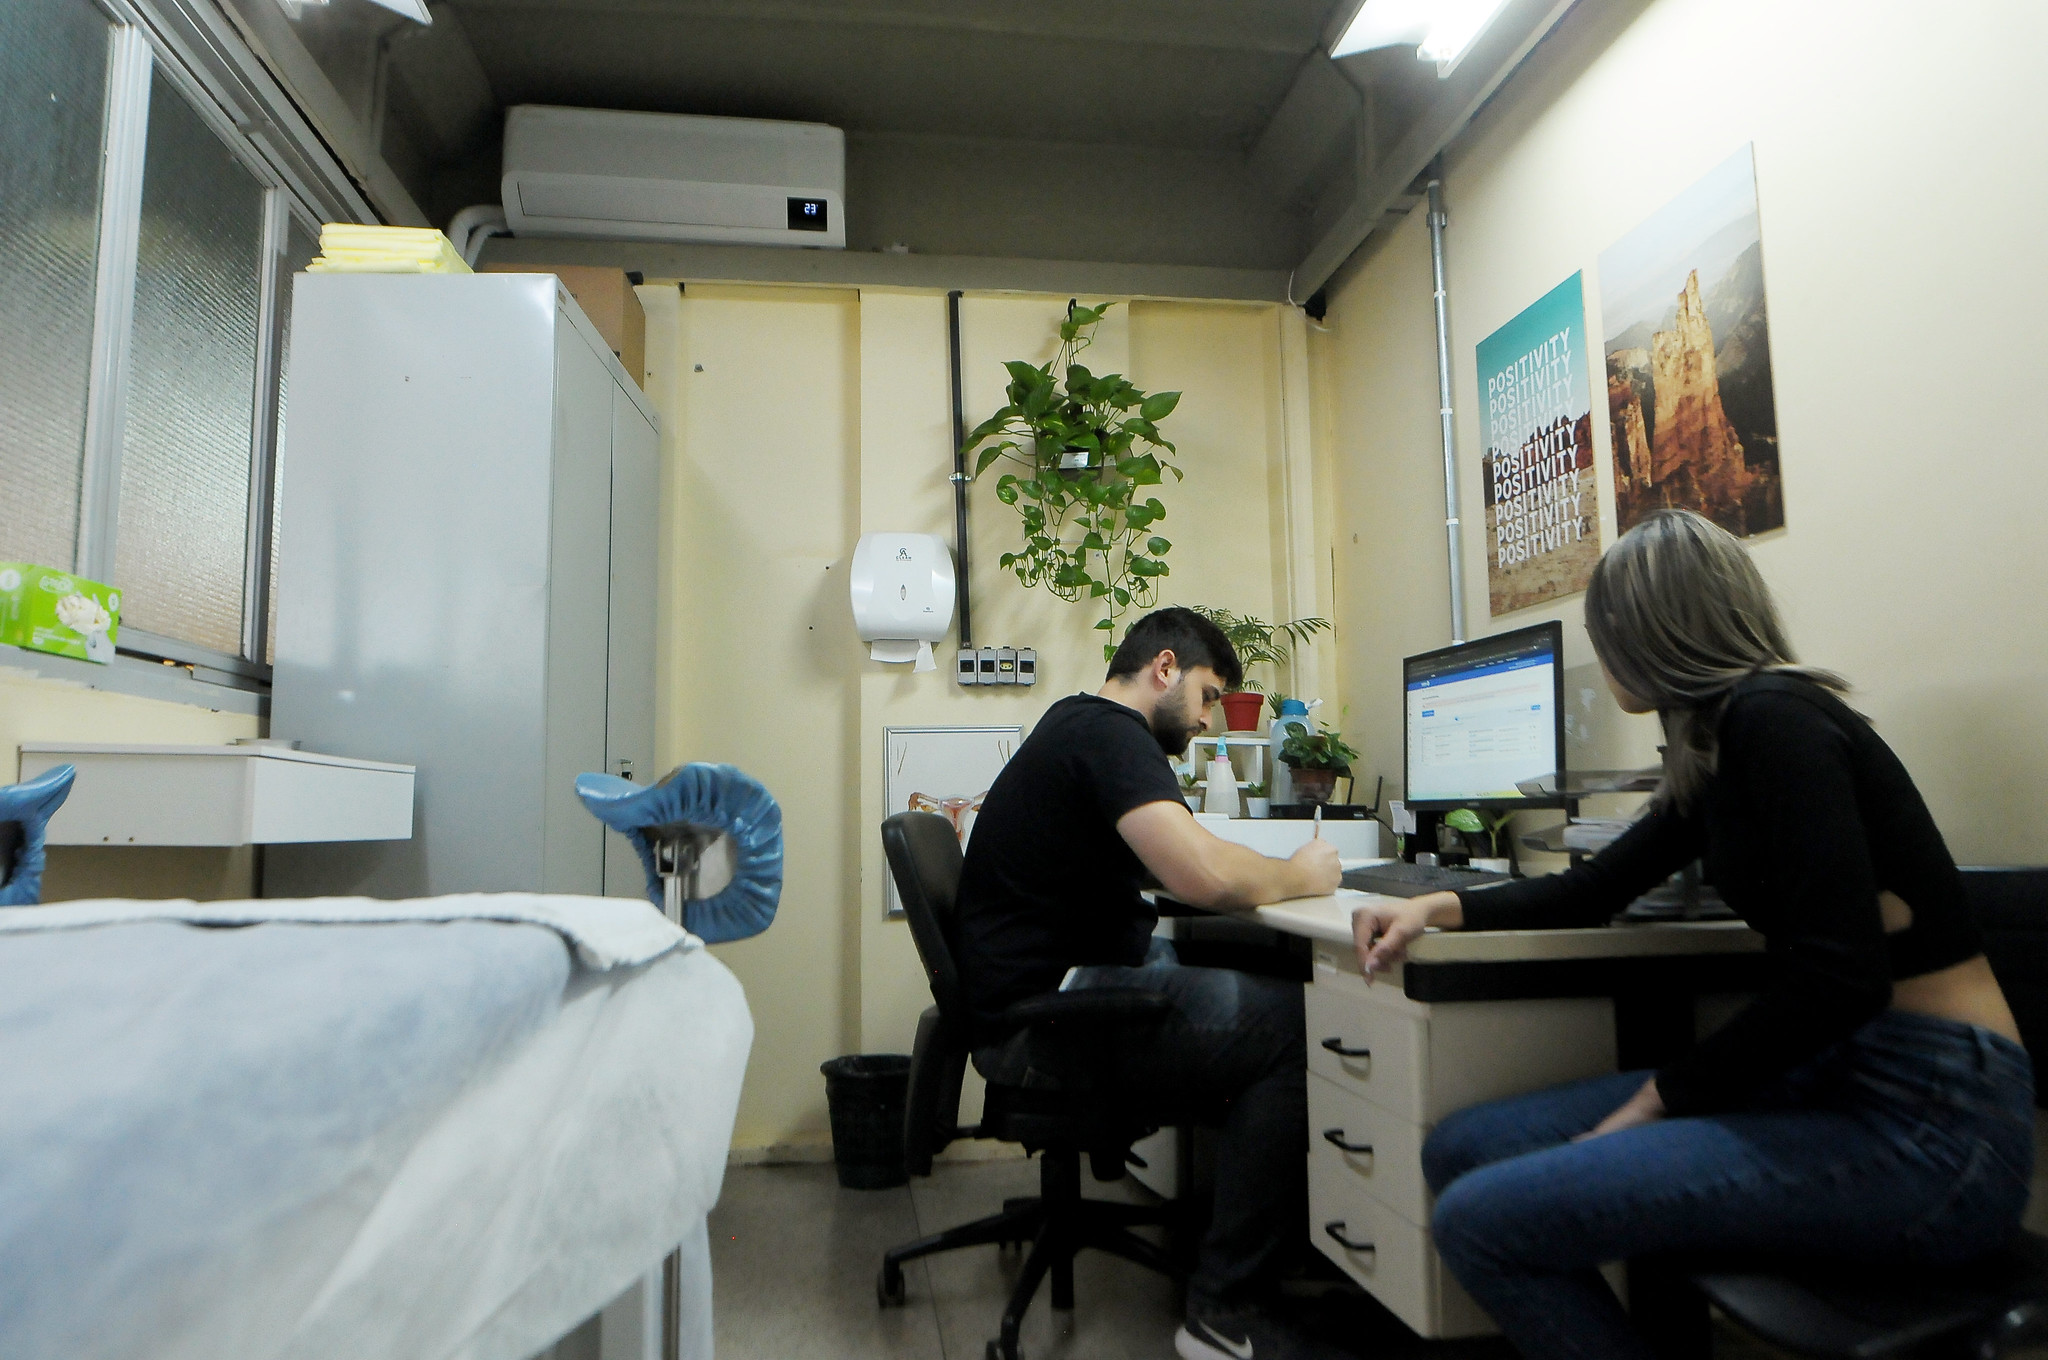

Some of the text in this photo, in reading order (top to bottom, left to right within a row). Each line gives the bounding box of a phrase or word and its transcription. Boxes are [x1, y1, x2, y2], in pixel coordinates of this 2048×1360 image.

[1488, 326, 1571, 397] POSITIVITY
[1489, 350, 1572, 416] POSITIVITY
[1490, 374, 1573, 440] POSITIVITY
[1491, 397, 1575, 462] POSITIVITY
[1493, 420, 1577, 483] POSITIVITY
[1494, 444, 1578, 504] POSITIVITY
[1495, 468, 1580, 525] POSITIVITY
[1497, 492, 1581, 547] POSITIVITY
[1498, 516, 1583, 568] POSITIVITY
